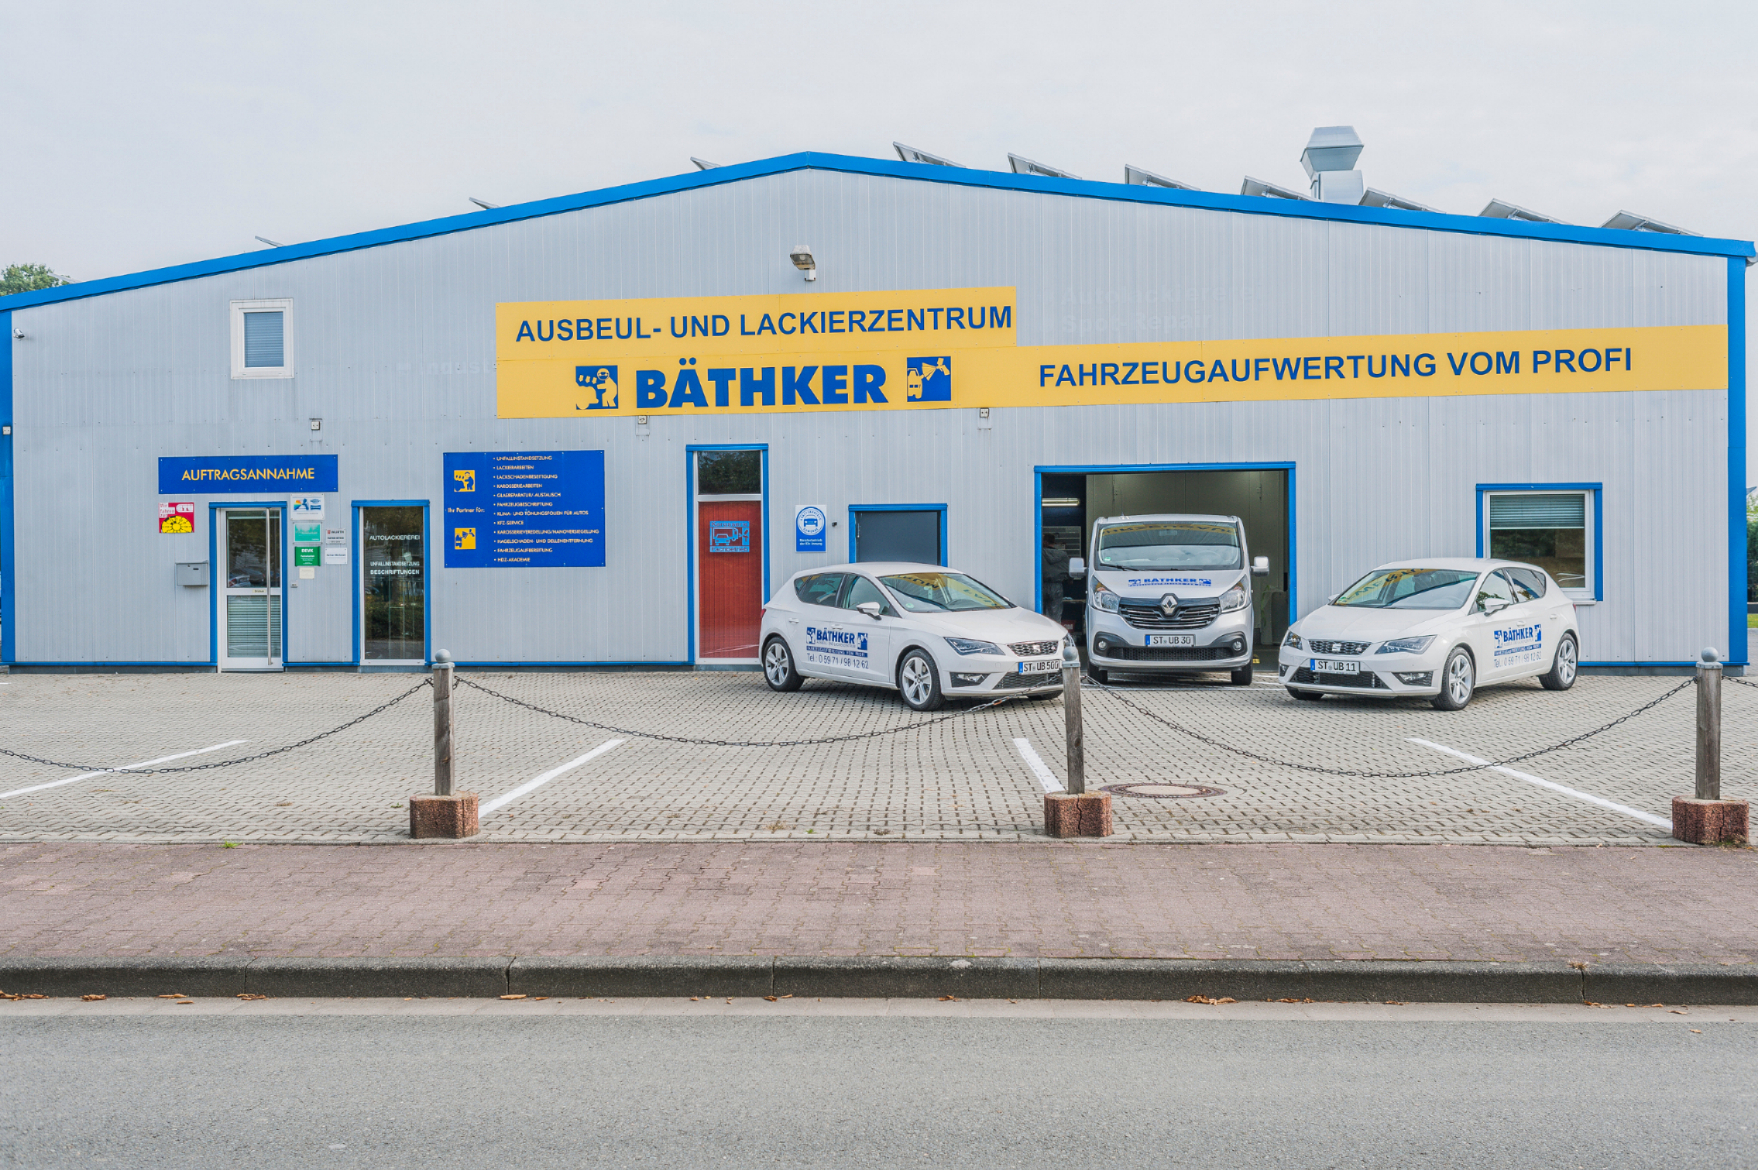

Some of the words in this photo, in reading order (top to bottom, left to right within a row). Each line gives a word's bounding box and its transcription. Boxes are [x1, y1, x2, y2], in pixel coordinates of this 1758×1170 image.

[516, 318, 661, 342] AUSBEUL-
[671, 315, 729, 338] UND
[741, 306, 1012, 336] LACKIERZENTRUM
[1040, 353, 1435, 387] FAHRZEUGAUFWERTUNG
[1447, 351, 1520, 376] VOM
[1533, 348, 1630, 373] PROFI
[636, 357, 888, 409] BÄTHKER
[182, 468, 314, 480] AUFTRAGSANNAHME
[817, 627, 855, 644] BÄTHKER
[1153, 636, 1163, 645] ST
[1169, 636, 1179, 645] UB
[1181, 636, 1191, 645] 30
[1503, 627, 1534, 642] BÄTHKER
[1024, 663, 1032, 672] ST
[1037, 661, 1046, 671] UB
[1047, 661, 1059, 670] 500
[1318, 661, 1328, 670] ST
[1333, 662, 1344, 671] UB
[1346, 663, 1356, 671] 11
